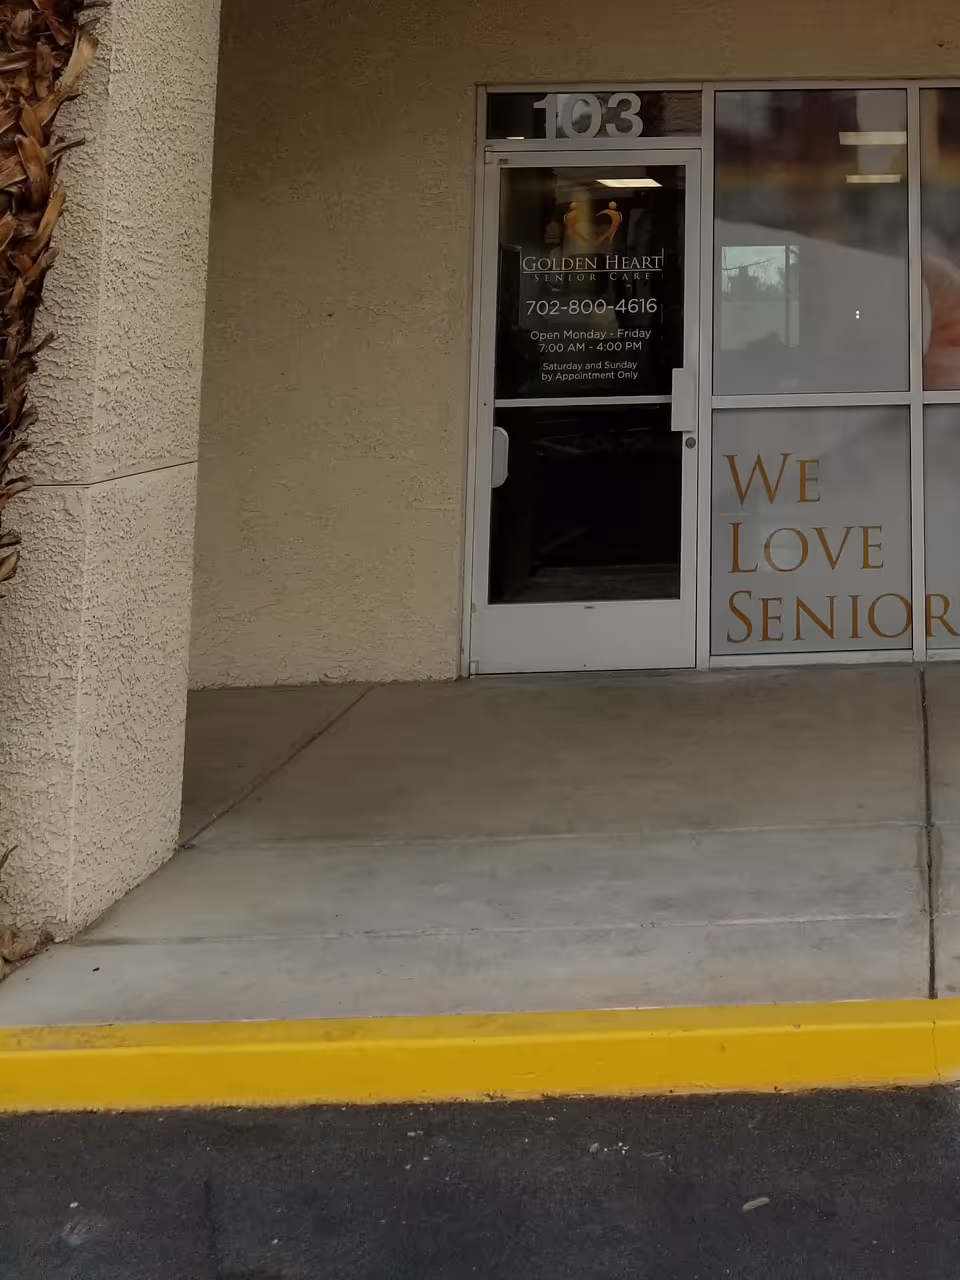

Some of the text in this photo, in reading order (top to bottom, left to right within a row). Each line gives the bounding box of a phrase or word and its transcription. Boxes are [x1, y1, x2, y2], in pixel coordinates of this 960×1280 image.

[533, 92, 643, 139] 103
[522, 255, 662, 271] GOLDEN HEART
[534, 272, 651, 282] SENIOR CARE
[525, 298, 658, 315] 702-800-4616
[530, 331, 560, 342] Open
[563, 330, 606, 341] Monday
[617, 328, 652, 340] Friday
[539, 343, 564, 353] 7:00
[567, 342, 585, 352] AM
[596, 342, 622, 352] 4:00
[625, 342, 642, 351] PM
[542, 361, 637, 372] Saturday and Sunday
[541, 371, 639, 382] by Appointment Only
[722, 452, 821, 506] WE
[727, 522, 884, 574] LOVE
